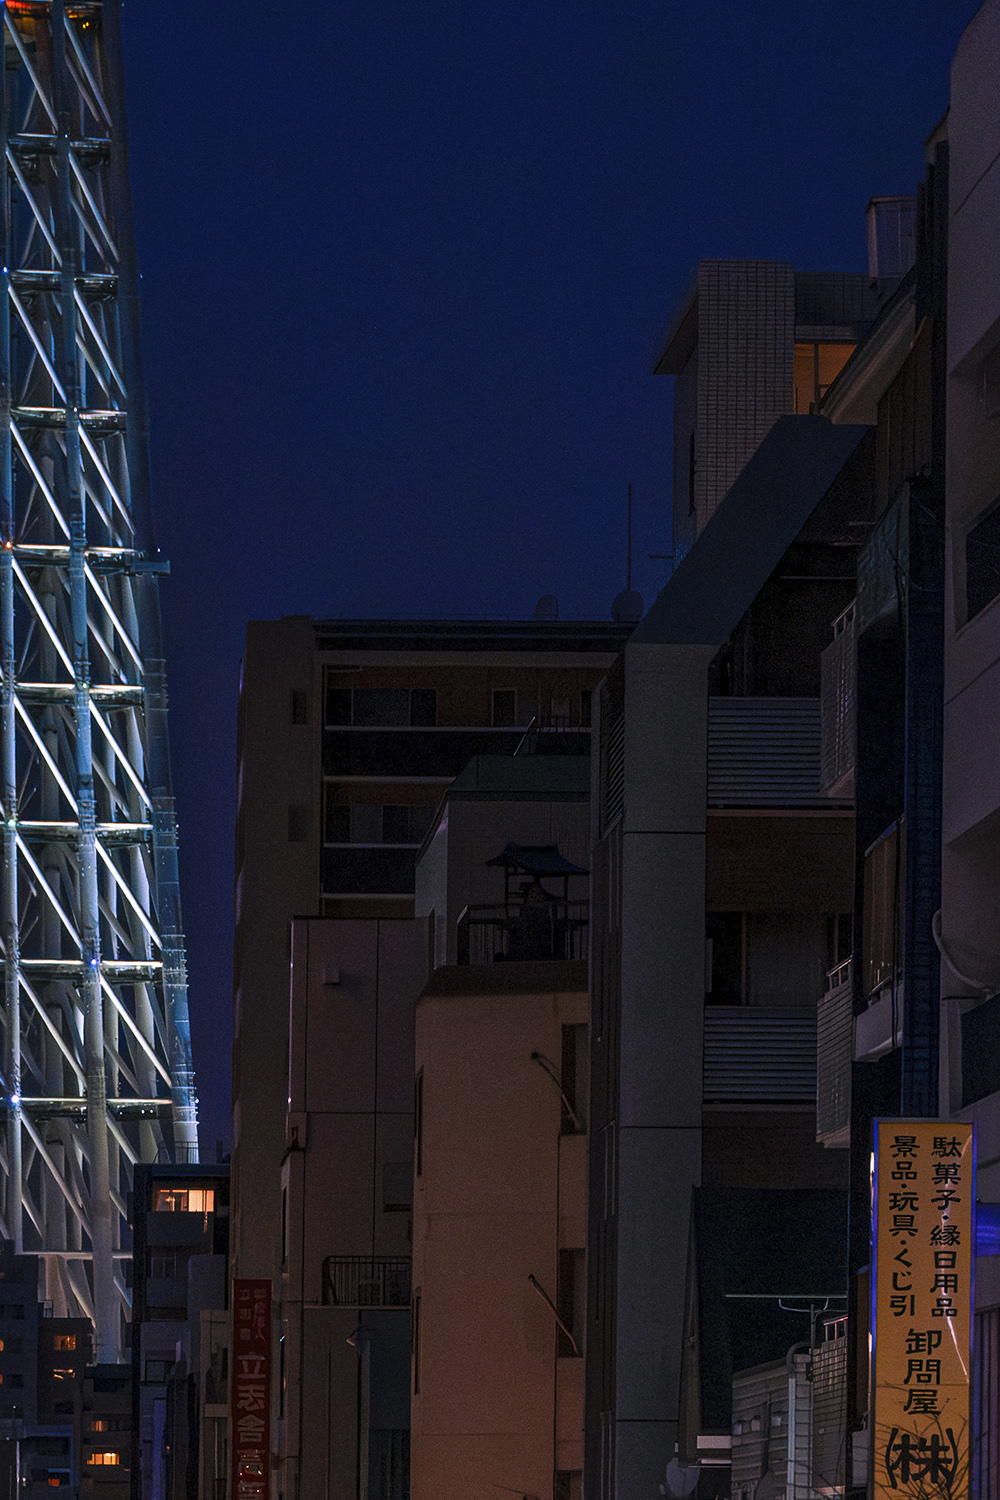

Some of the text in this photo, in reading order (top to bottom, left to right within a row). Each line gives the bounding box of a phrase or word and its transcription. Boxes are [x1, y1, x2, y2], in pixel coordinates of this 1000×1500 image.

[889, 1135, 920, 1316] 景品・玩具・くじ引
[930, 1137, 961, 1318] 駄菓子・縁日用品
[903, 1328, 942, 1416] 卸問屋
